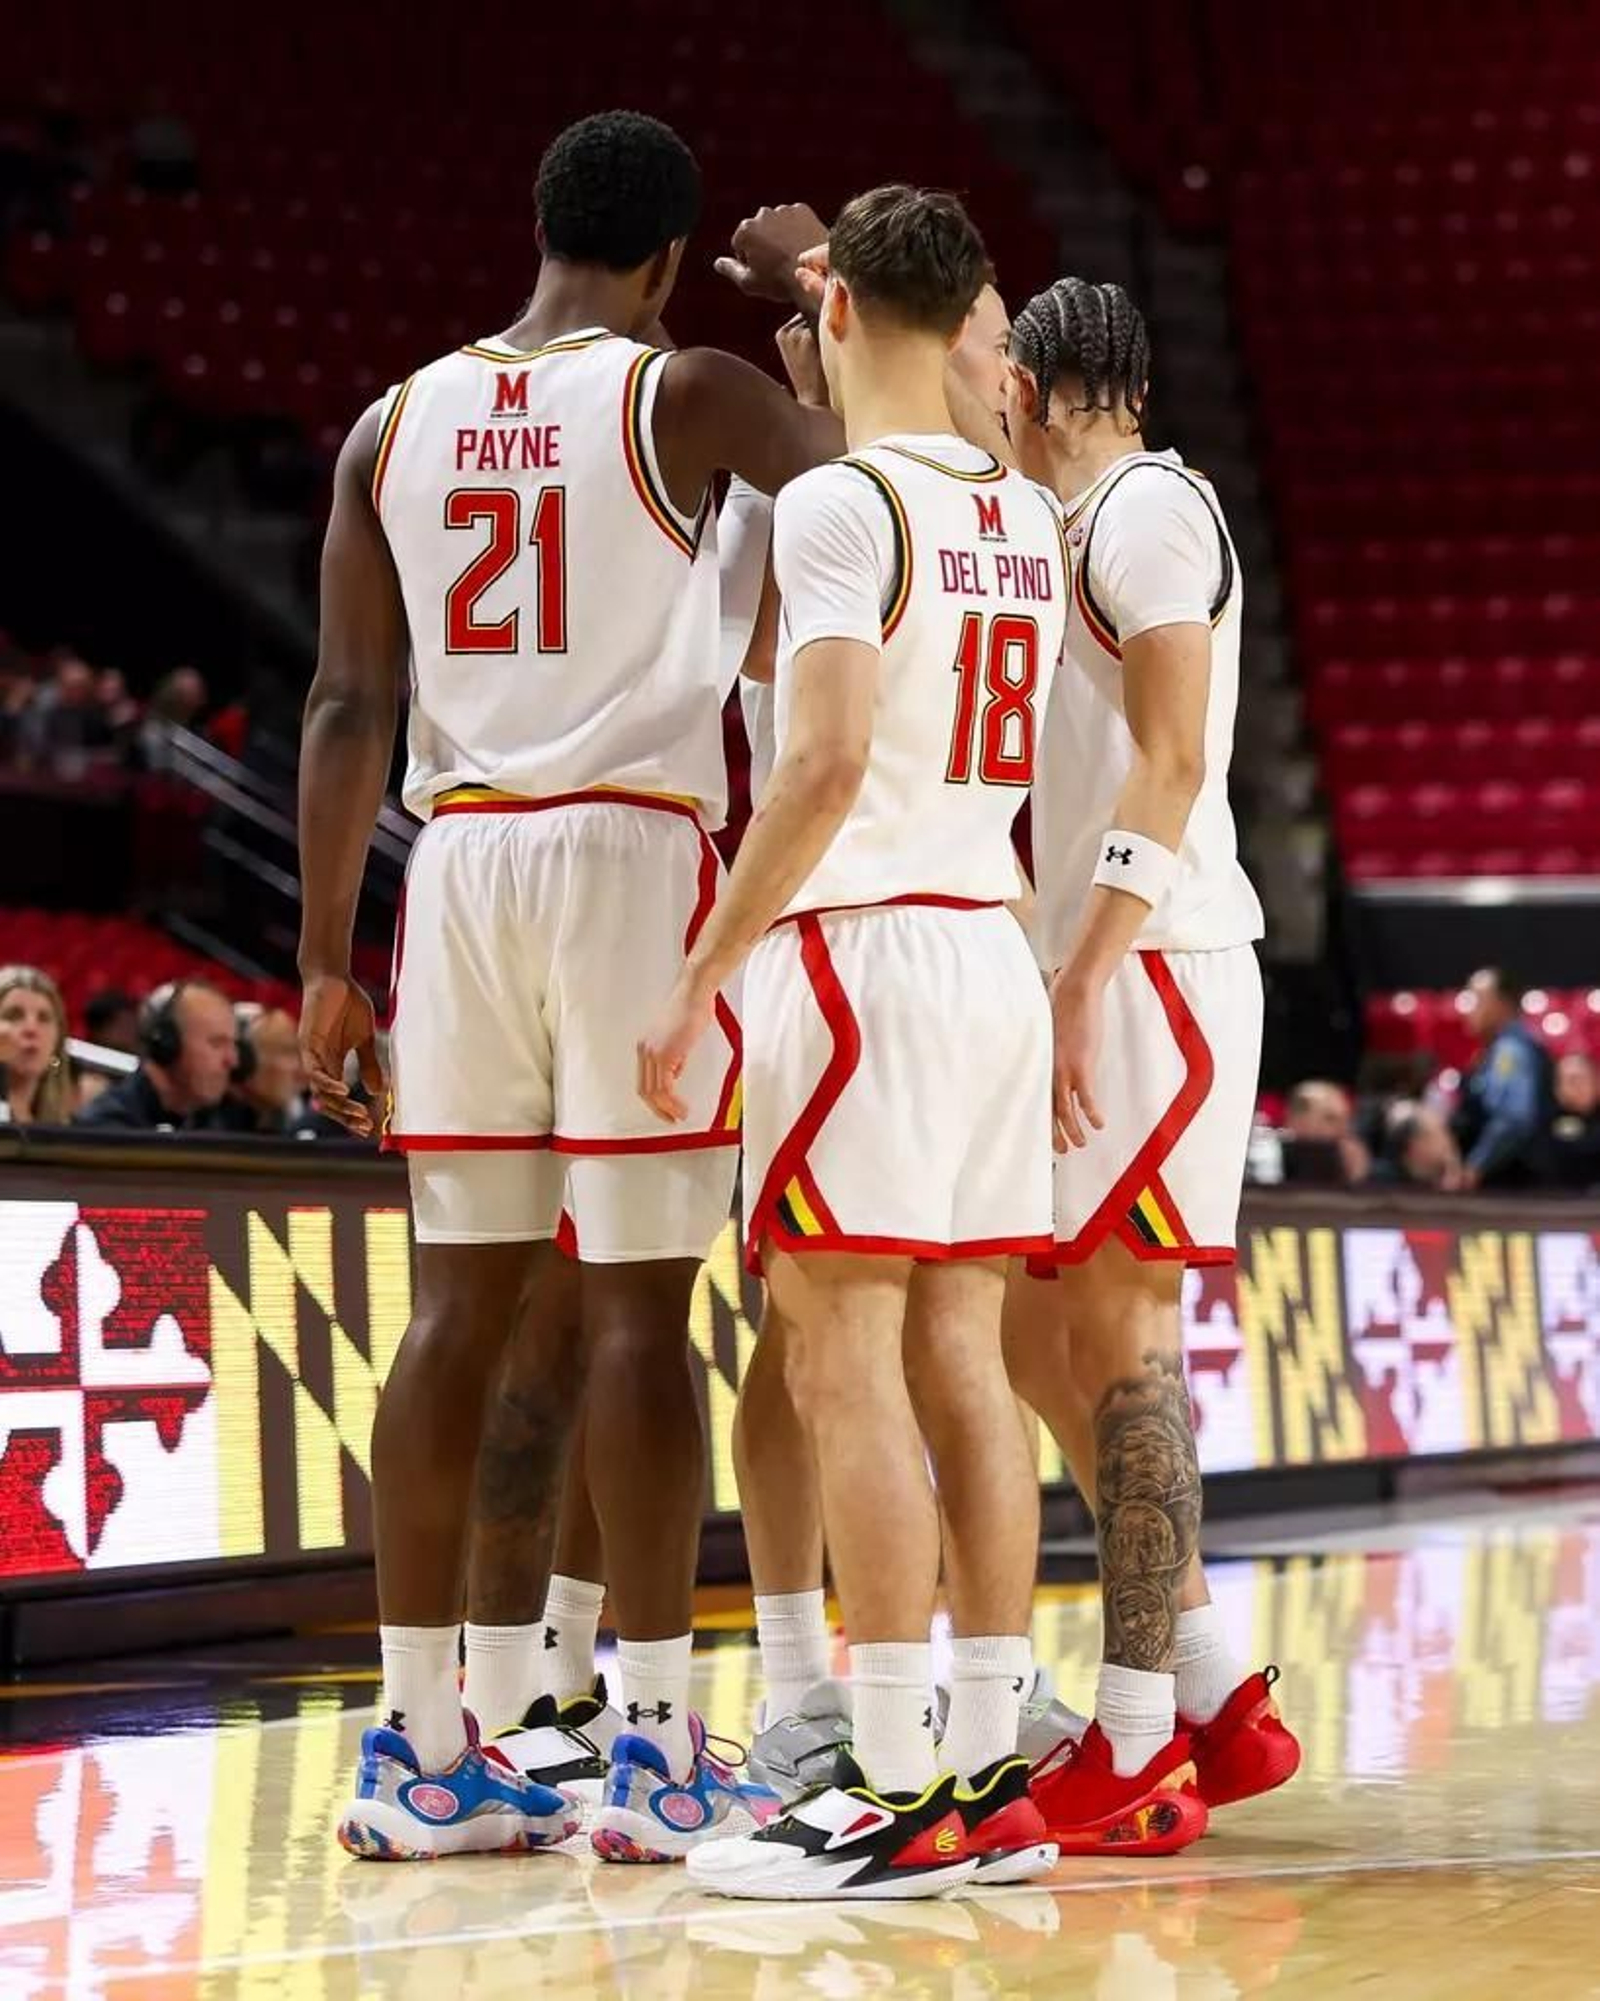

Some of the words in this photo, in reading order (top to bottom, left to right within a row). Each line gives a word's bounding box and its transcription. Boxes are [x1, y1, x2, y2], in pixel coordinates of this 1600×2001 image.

[493, 372, 529, 411] M
[456, 426, 560, 471] PAYNE
[970, 493, 1006, 535] M
[445, 486, 567, 655] 21
[938, 549, 987, 596] DEL
[995, 555, 1051, 601] PINO
[944, 611, 1039, 787] 18
